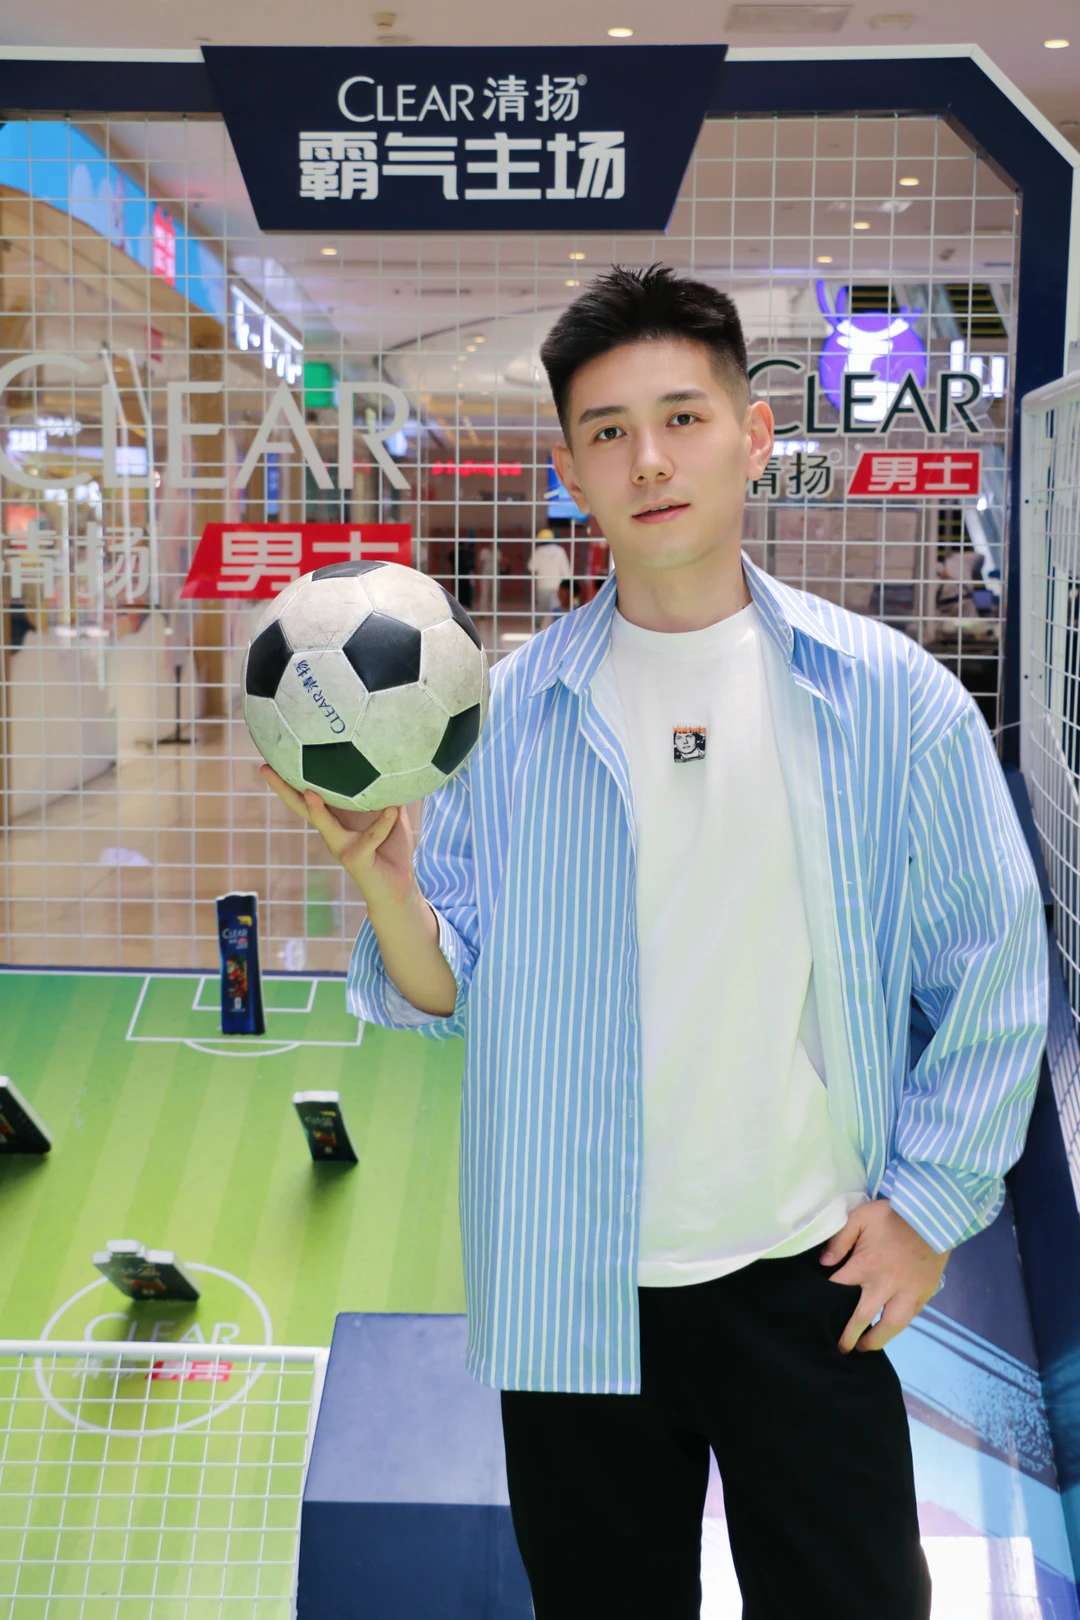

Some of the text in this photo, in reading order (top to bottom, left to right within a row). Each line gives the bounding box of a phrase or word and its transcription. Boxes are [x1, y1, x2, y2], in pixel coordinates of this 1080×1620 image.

[338, 75, 580, 122] CLEAR 清扬
[299, 131, 625, 200] 霸气主场
[0, 353, 411, 490] CLEAR
[868, 456, 974, 491] 男士
[312, 689, 346, 734] CLEAR
